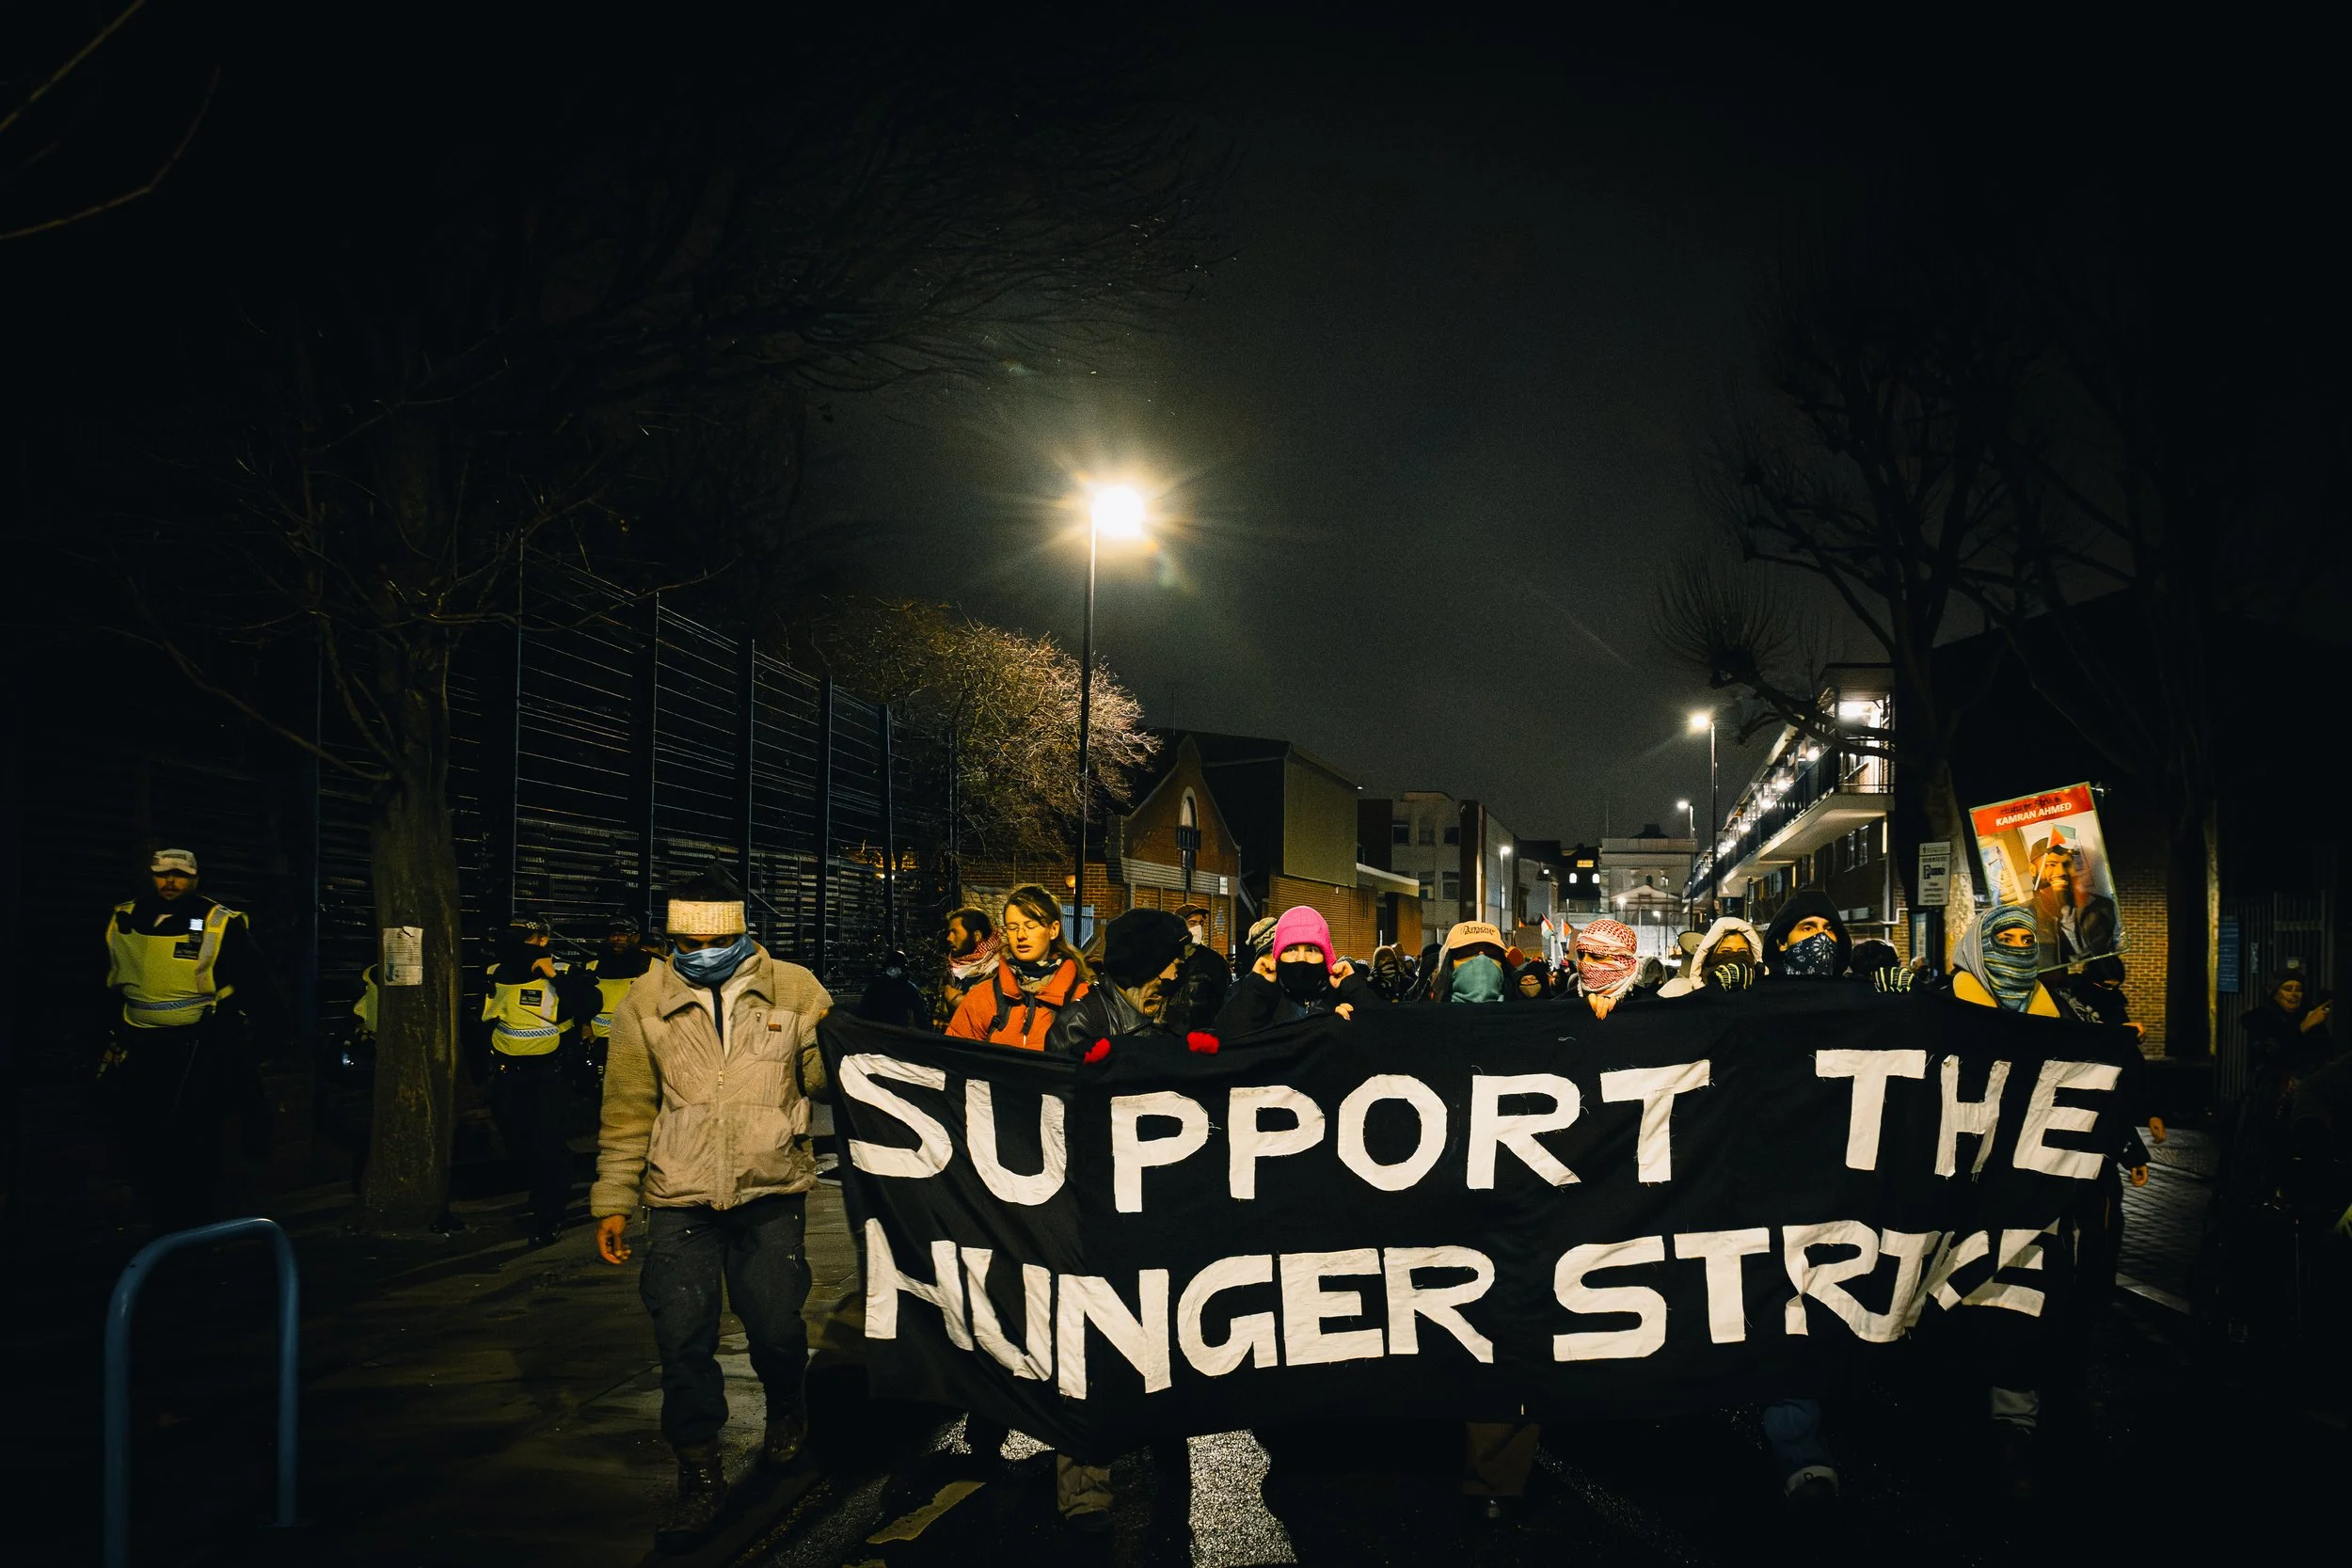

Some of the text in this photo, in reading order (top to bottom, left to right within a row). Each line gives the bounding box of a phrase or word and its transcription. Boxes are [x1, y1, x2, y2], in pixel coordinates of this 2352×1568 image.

[1995, 802, 2073, 827] KAMRAN AHMED
[838, 1049, 2122, 1212] SUPPORT THE
[864, 1217, 2060, 1400] HUNGER STRIKE
